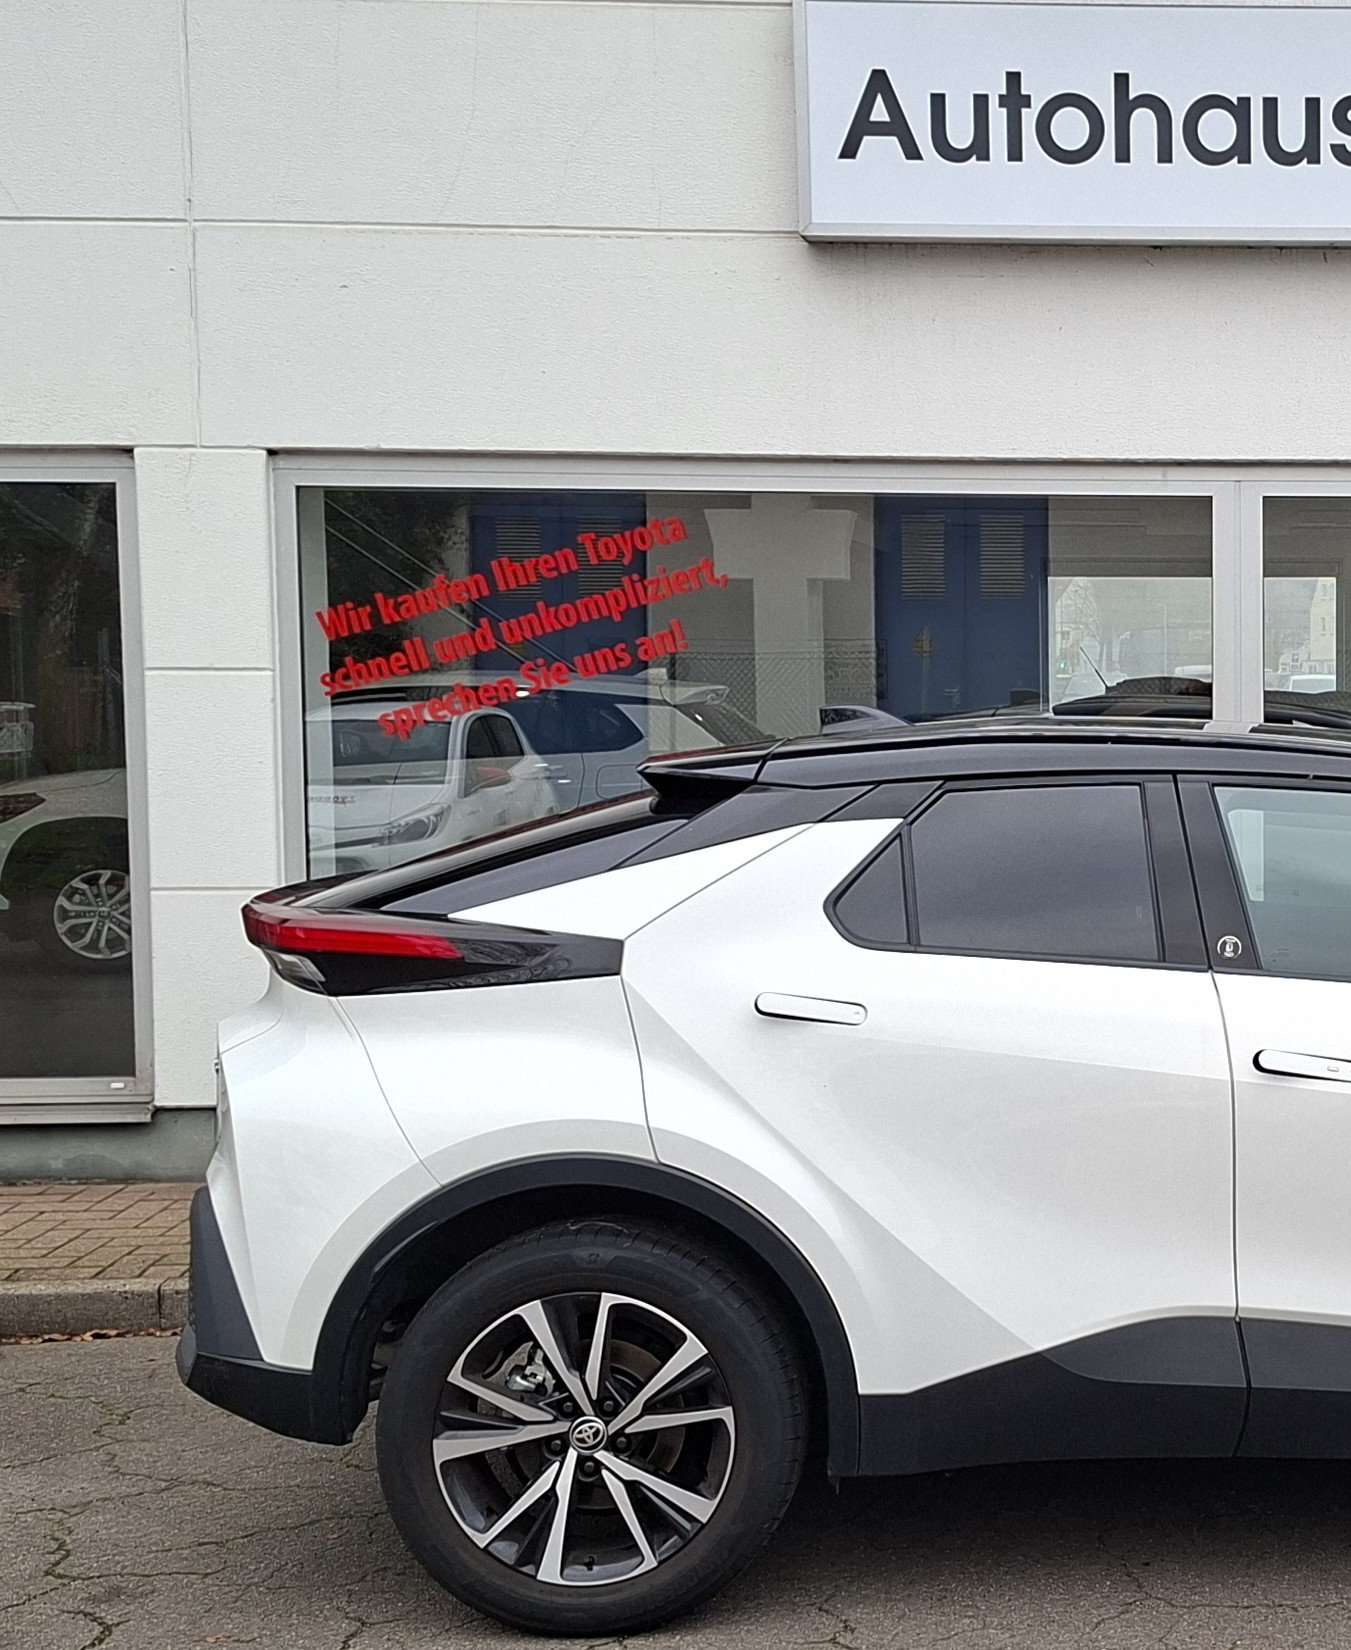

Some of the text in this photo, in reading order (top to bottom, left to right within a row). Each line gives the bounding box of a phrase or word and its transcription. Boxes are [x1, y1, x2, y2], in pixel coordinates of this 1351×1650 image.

[315, 517, 688, 641] Wir kaufen Ihren Toyota
[320, 559, 729, 697] schnell und unkompliziert,
[377, 619, 689, 741] sprechen Sie uns an!
